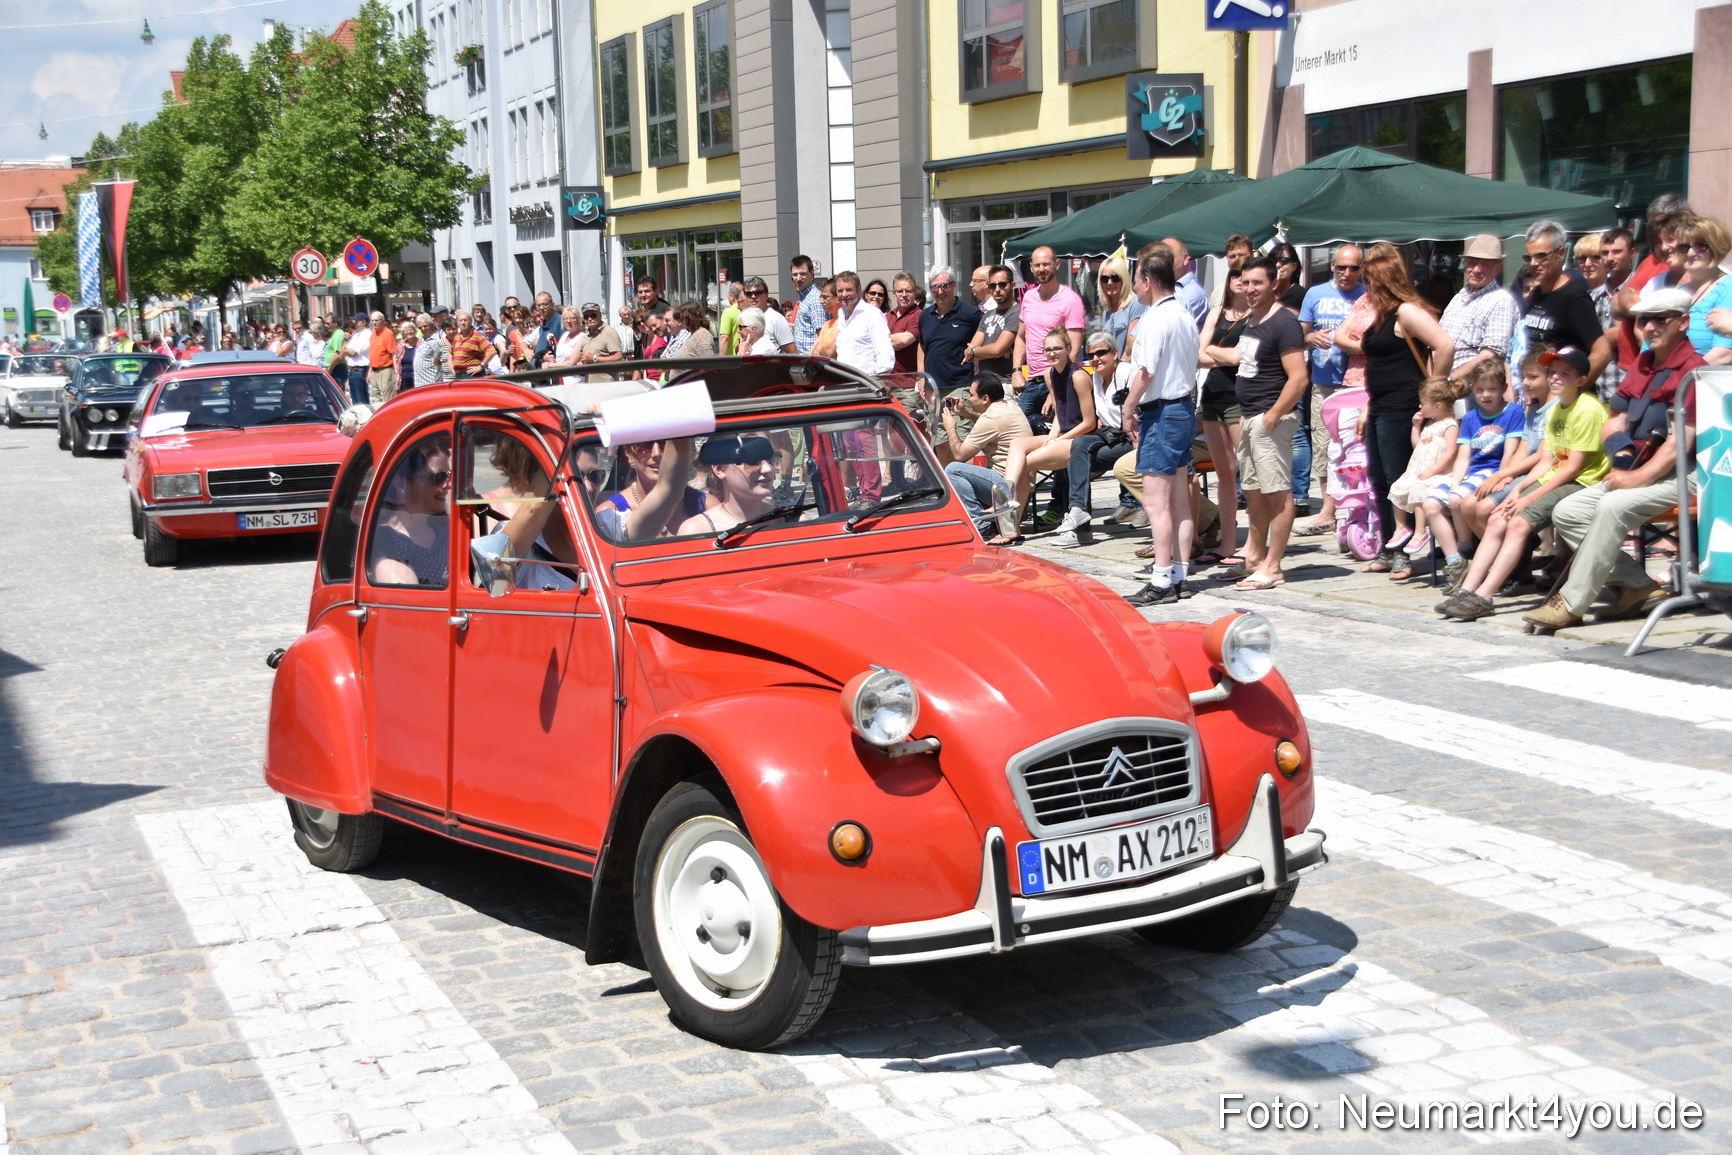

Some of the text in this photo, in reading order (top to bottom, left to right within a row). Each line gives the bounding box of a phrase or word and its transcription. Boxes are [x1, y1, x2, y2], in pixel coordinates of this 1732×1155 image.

[1295, 44, 1358, 72] Unterer Markt 15
[1158, 96, 1185, 132] G2
[578, 197, 593, 216] G2
[300, 258, 320, 275] 30
[1539, 318, 1550, 330] 81
[246, 516, 264, 527] NM
[273, 515, 289, 526] SL
[292, 512, 317, 524] 73H
[1197, 812, 1207, 824] 05
[1028, 817, 1198, 885] D NM AX 212
[1198, 838, 1209, 850] 10
